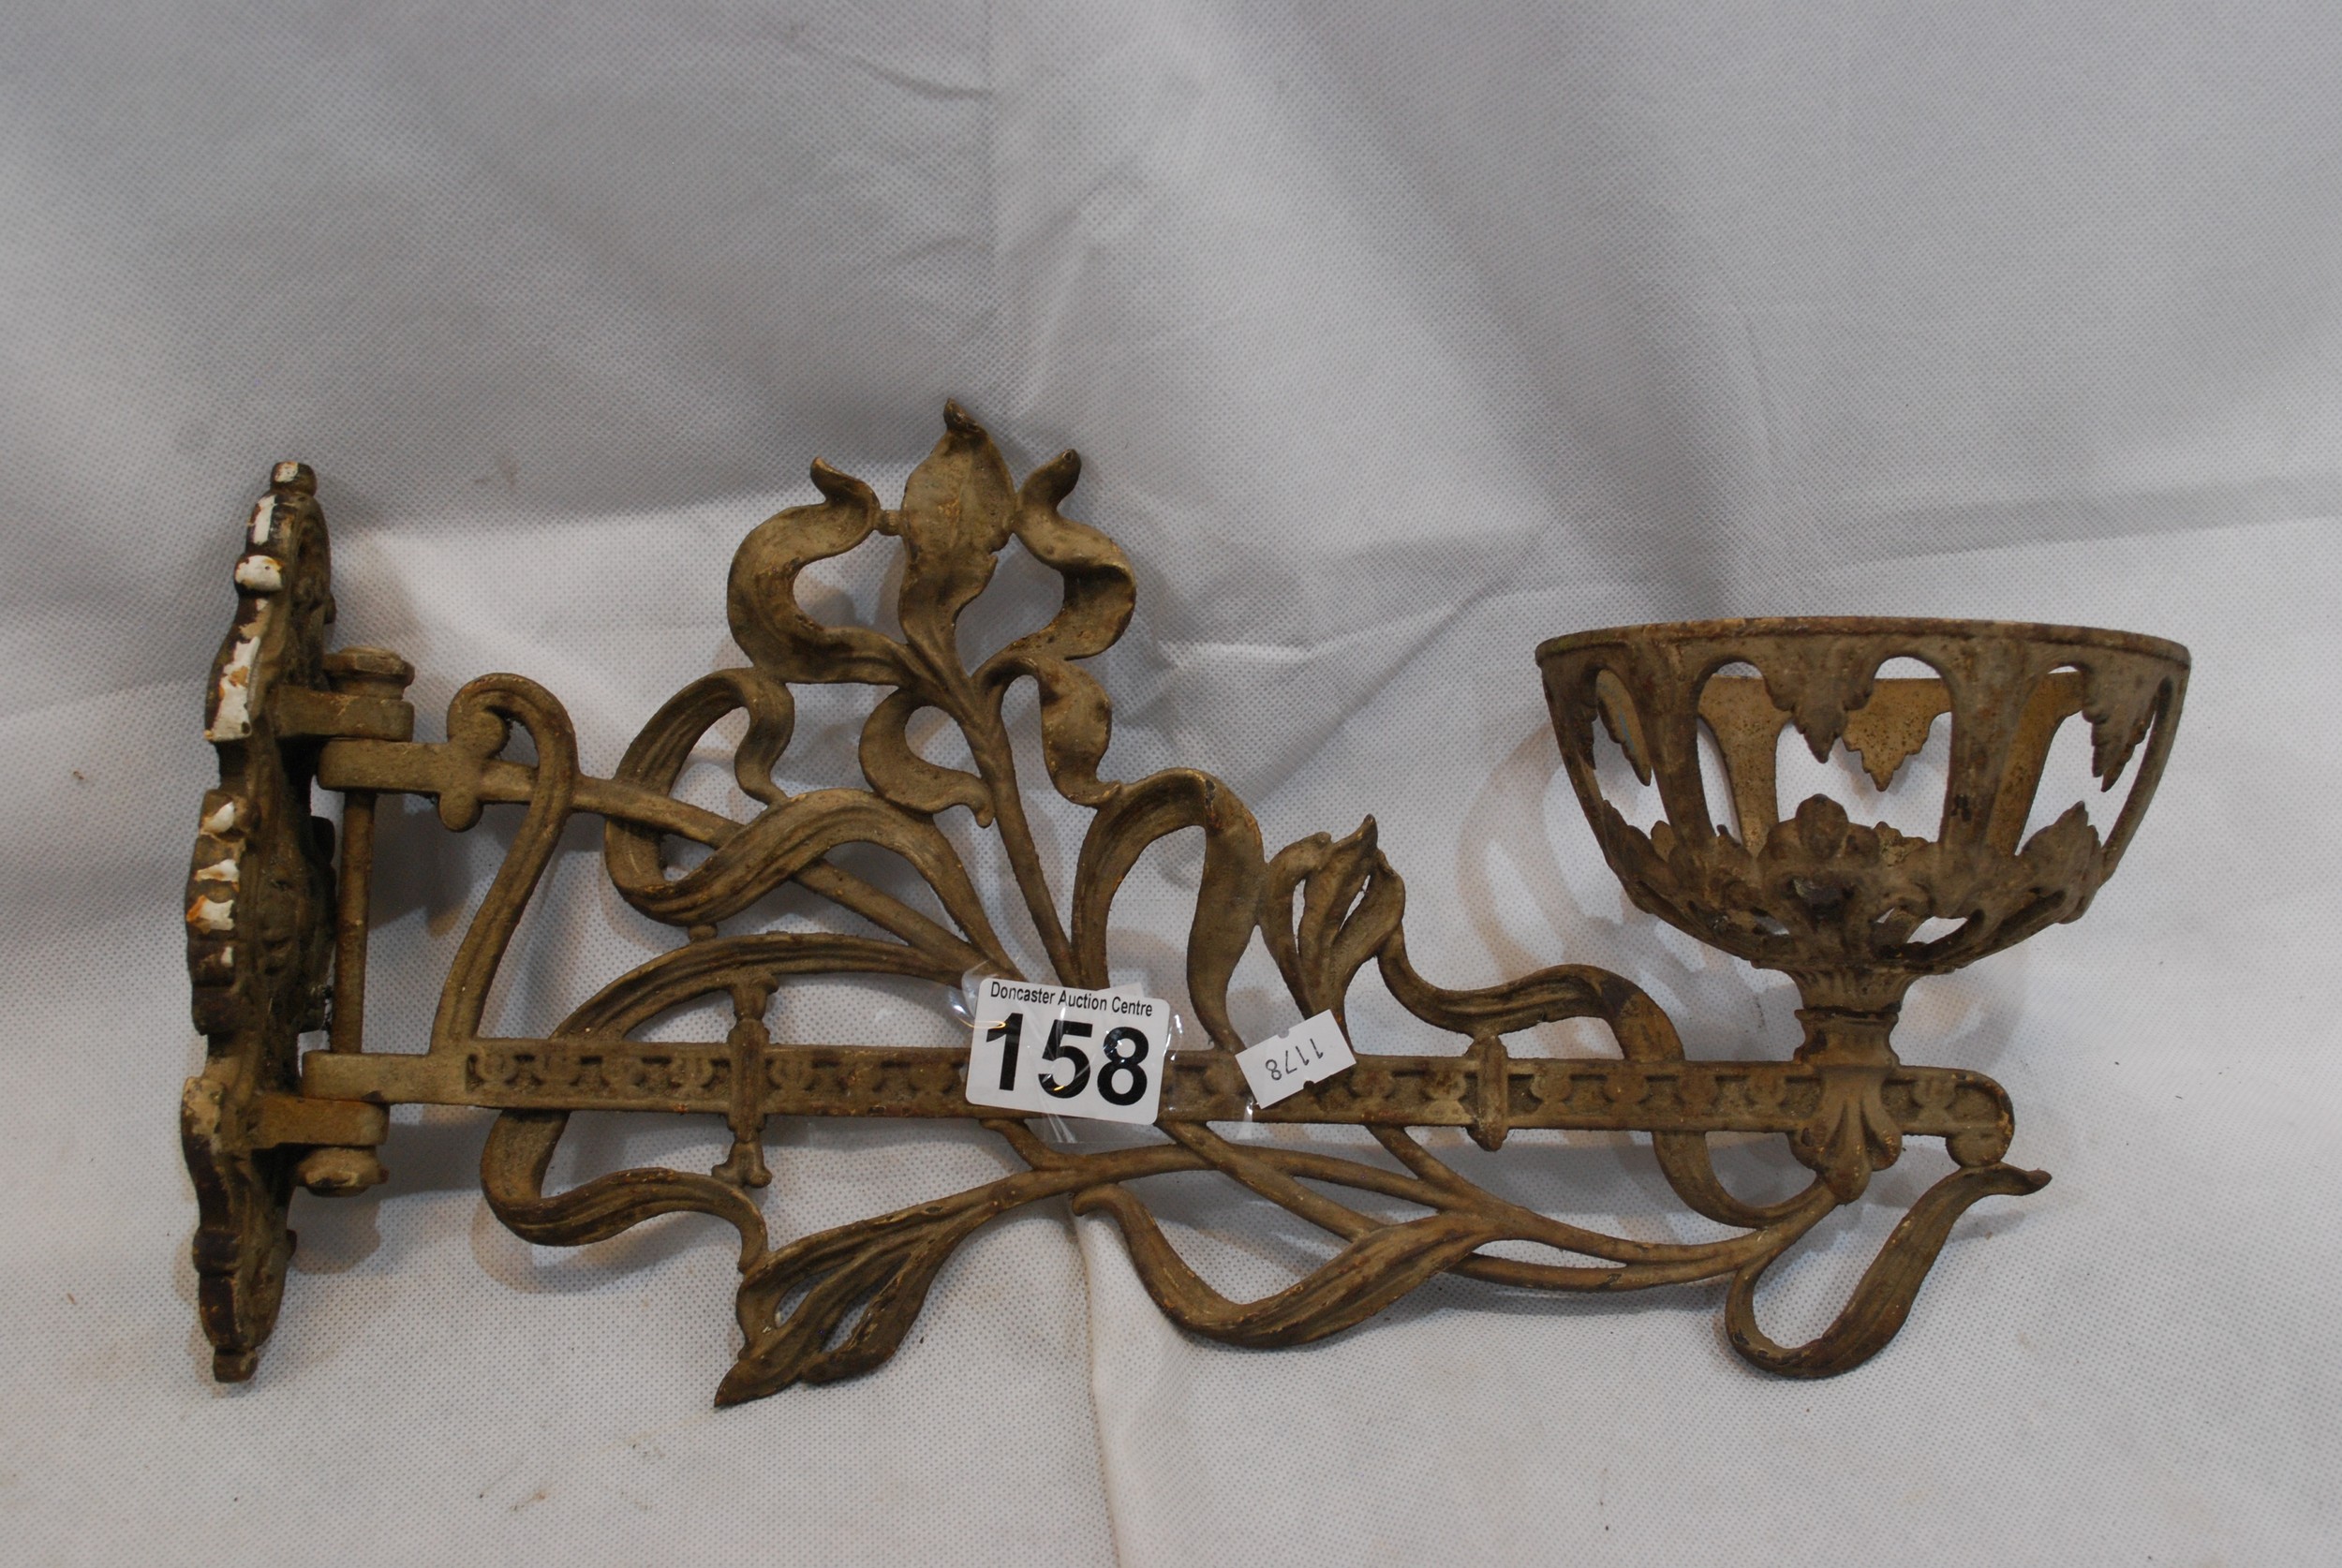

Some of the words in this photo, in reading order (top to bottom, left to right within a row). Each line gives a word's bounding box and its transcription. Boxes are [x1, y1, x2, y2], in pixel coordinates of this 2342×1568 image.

[990, 981, 1056, 1005] Doncaster
[1058, 989, 1107, 1011] Auction
[1111, 996, 1153, 1017] Centre
[986, 1012, 1149, 1106] 158
[1264, 1038, 1325, 1082] 1178
